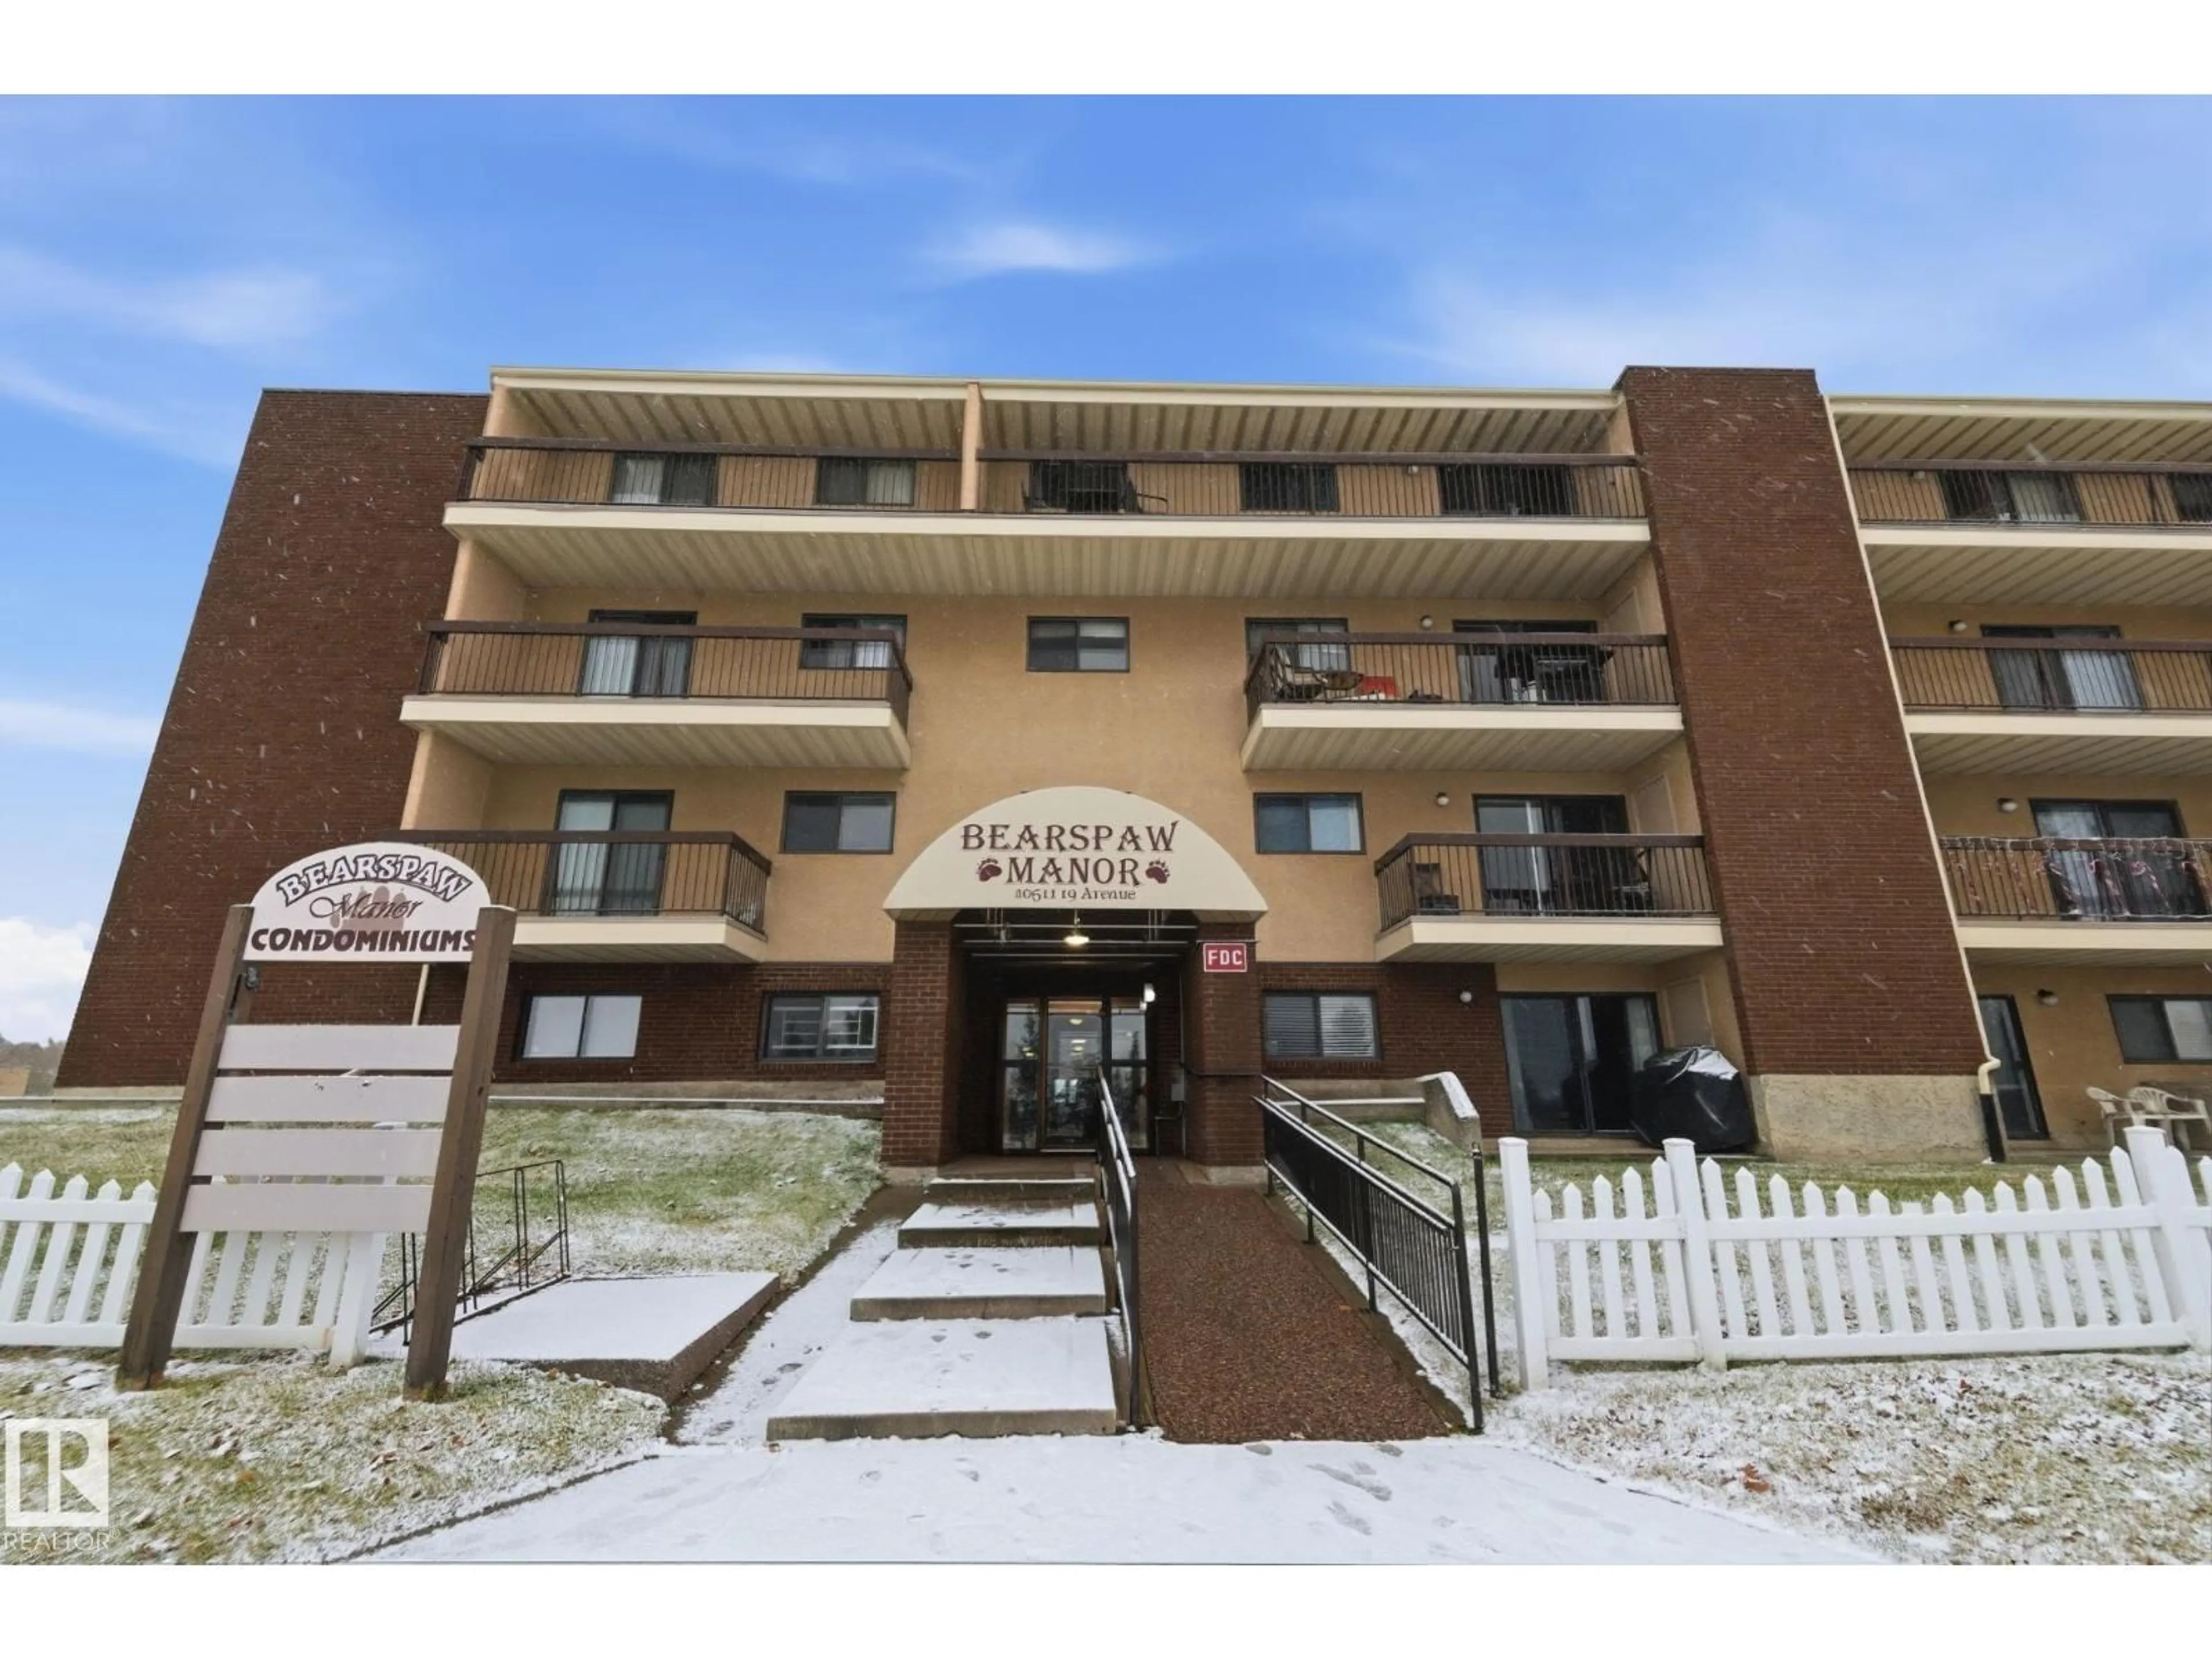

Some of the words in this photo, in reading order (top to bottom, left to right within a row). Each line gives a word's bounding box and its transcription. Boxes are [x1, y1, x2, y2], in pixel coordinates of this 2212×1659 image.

[961, 820, 1179, 853] BEARSPAW
[276, 854, 473, 907] BEARSPAW
[1006, 857, 1141, 886] MANOR
[309, 892, 424, 920] Manor
[1062, 888, 1077, 901] 19
[252, 928, 476, 952] CONDOMINIUMS
[1207, 949, 1243, 966] FDC
